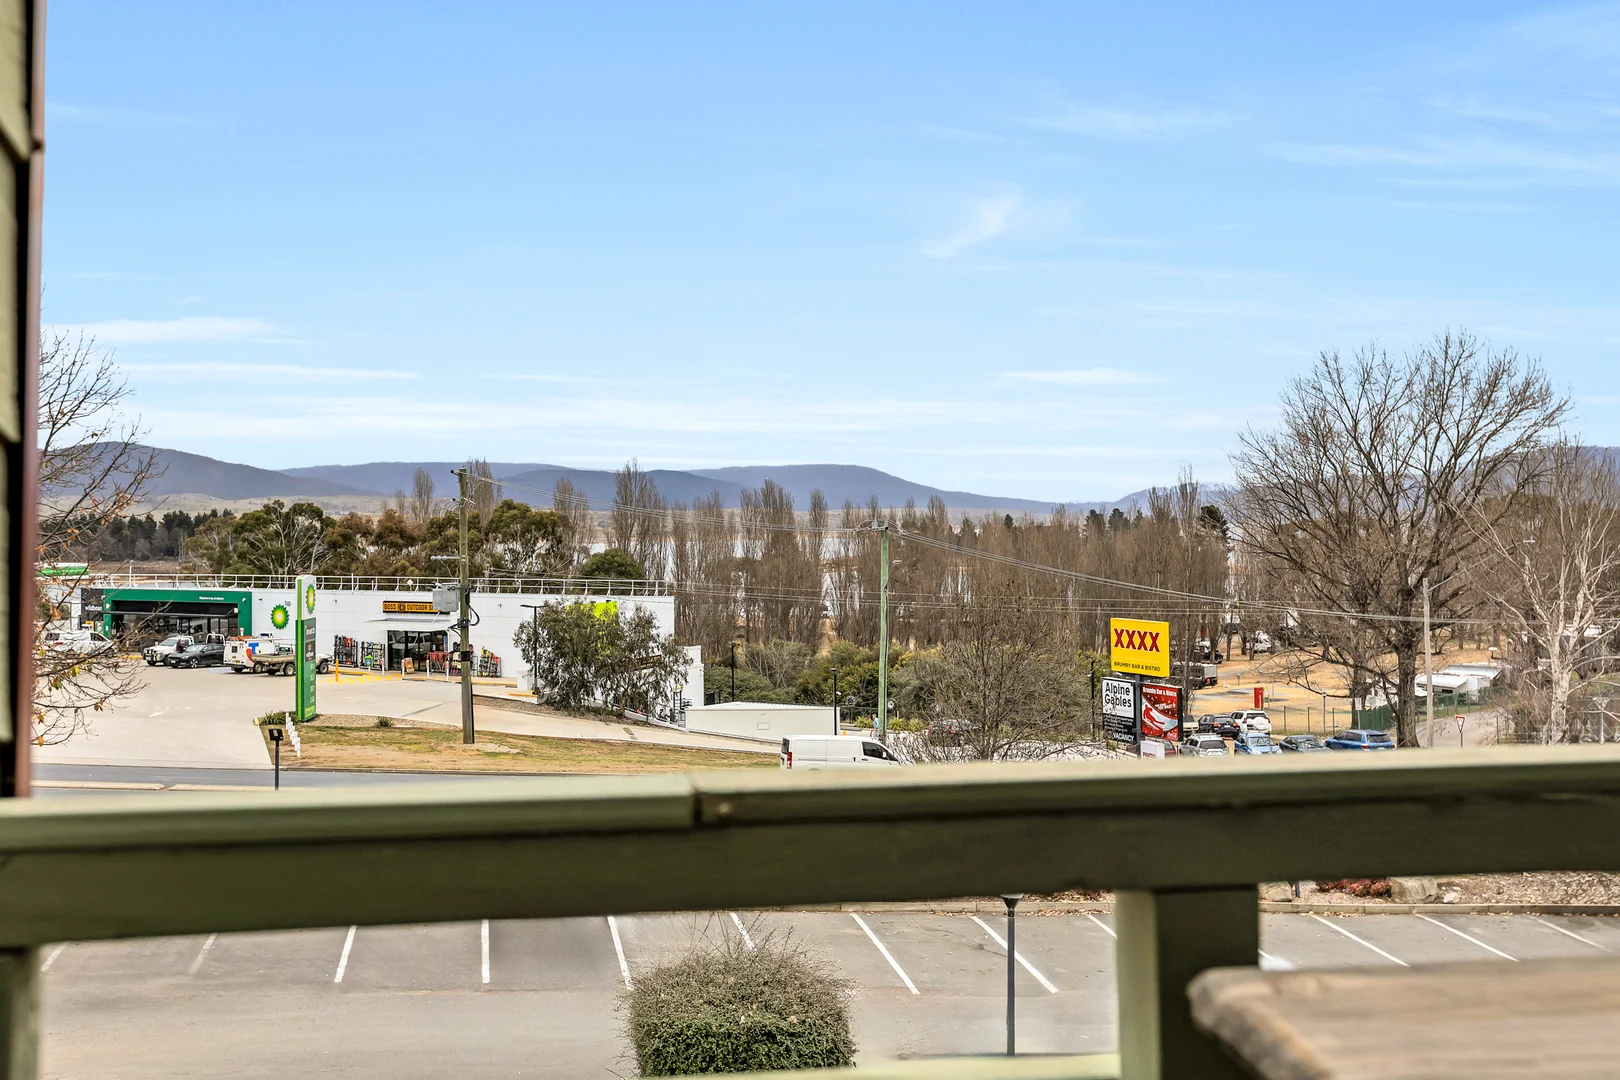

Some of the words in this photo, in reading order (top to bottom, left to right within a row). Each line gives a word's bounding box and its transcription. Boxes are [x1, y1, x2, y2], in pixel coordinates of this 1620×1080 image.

[1114, 629, 1160, 652] XXXX
[1145, 664, 1160, 672] BISTRO
[1105, 682, 1131, 697] Alpine
[1104, 693, 1132, 708] Gables
[1113, 731, 1135, 742] VACANCY
